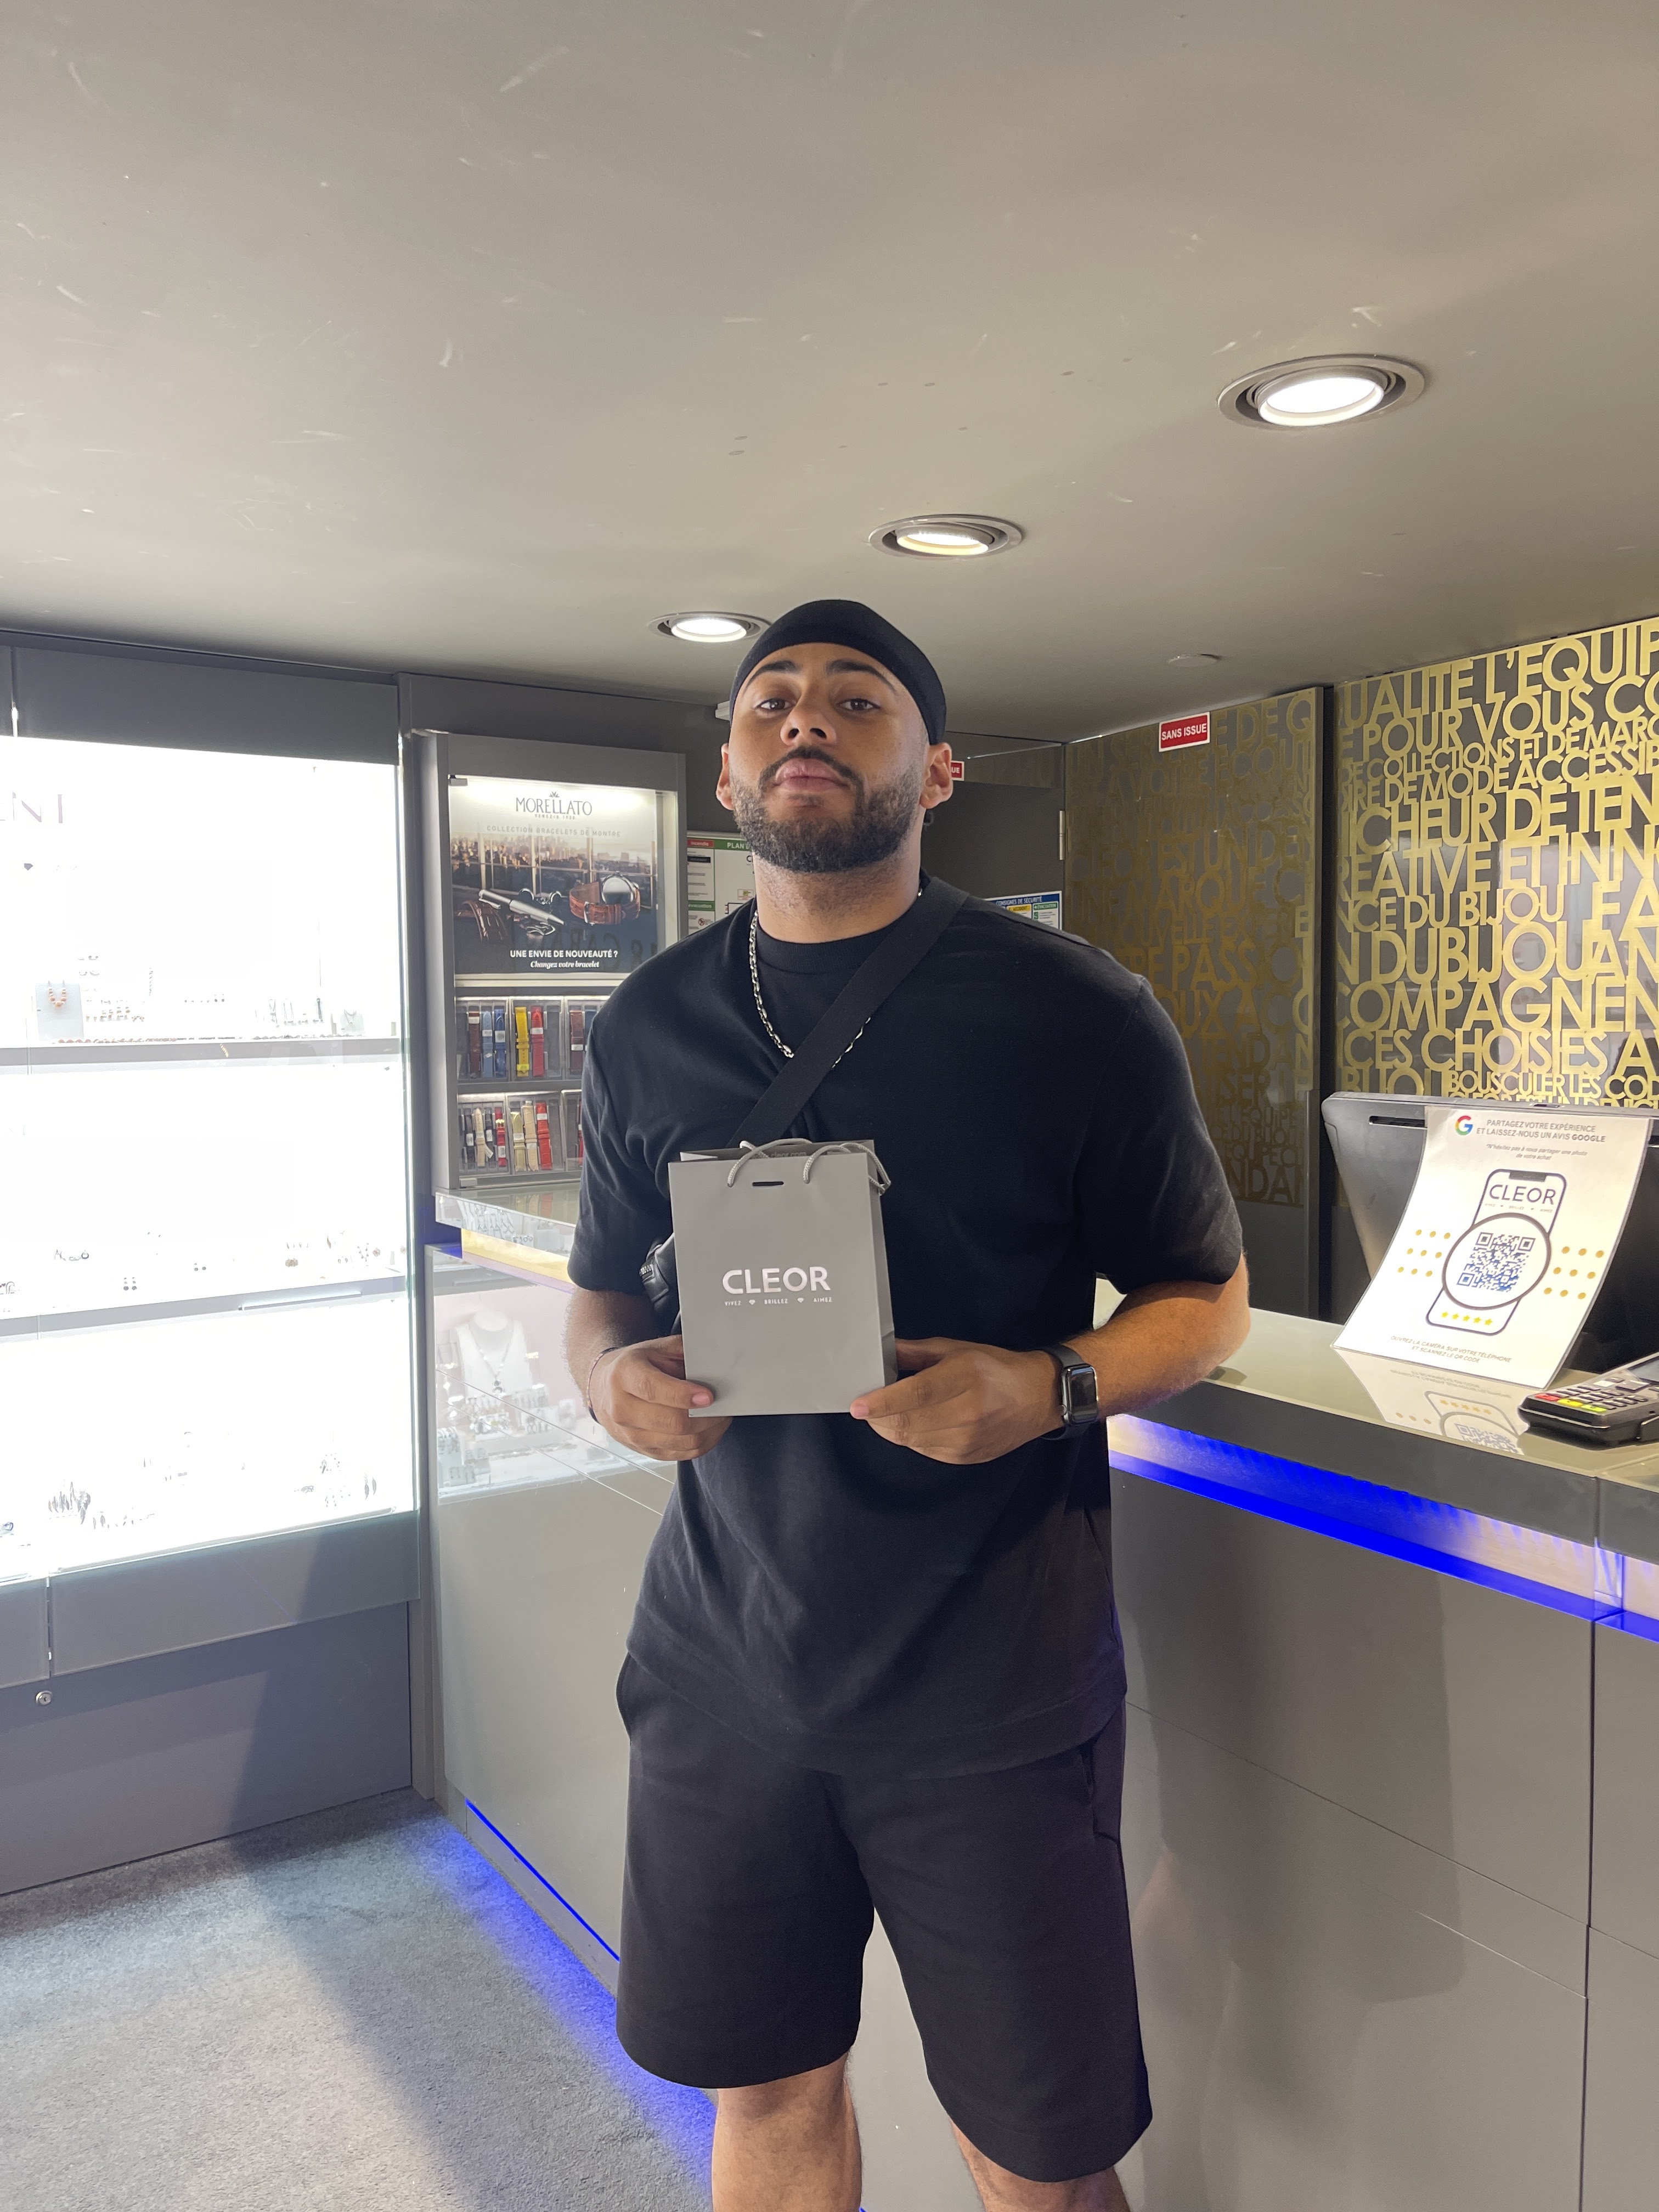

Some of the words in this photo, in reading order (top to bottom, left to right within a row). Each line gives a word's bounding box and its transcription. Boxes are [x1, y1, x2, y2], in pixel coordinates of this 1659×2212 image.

[1486, 619, 1659, 705] L'EQUIP
[1161, 728, 1182, 741] SANS
[1183, 723, 1207, 737] ISSUE
[1363, 708, 1464, 763] POUR
[1472, 682, 1594, 744] VOUS
[1367, 737, 1515, 782] COLLECTIONS
[1520, 731, 1543, 761] ET
[1548, 727, 1579, 757] DE
[1385, 778, 1418, 809] DE
[1420, 761, 1509, 802] MODE
[1513, 741, 1659, 790] ACCESSIB
[516, 797, 592, 816] MORELLATO
[1342, 794, 1497, 856] ICHEUR
[1505, 781, 1568, 840] DE
[487, 825, 533, 833] COLLECTION
[1503, 833, 1549, 889] ET
[1558, 823, 1659, 885] INN
[1404, 893, 1451, 929] DU
[1459, 884, 1565, 927] BIJOU
[510, 950, 527, 958] UNE
[528, 950, 551, 958] ENVIE
[554, 950, 563, 958] DE
[565, 948, 612, 958] NOUVEAUTÉ
[613, 950, 618, 958] ?
[530, 960, 557, 970] Changez
[1172, 937, 1313, 991] PASSIO
[1372, 926, 1438, 985] DU
[1438, 919, 1593, 984] BIJOU
[1421, 1028, 1608, 1077] CHOISIES
[1449, 1069, 1566, 1097] BOUSCULER
[1569, 1073, 1602, 1098] LES
[1487, 1119, 1524, 1128] PARTAGEZ
[1550, 1122, 1596, 1133] EXPÉRIENCE
[1487, 1128, 1539, 1138] LAISSEZ-NOUS
[1571, 1133, 1606, 1143] GOOGLE
[1489, 1184, 1556, 1205] CLEOR
[721, 1266, 831, 1295] CLEOR
[1391, 1335, 1413, 1344] OUVREZ
[1421, 1341, 1445, 1350] CAMÉRA
[1478, 1351, 1512, 1363] TÉLÉPHONE
[1420, 1347, 1447, 1357] SCANNEZ
